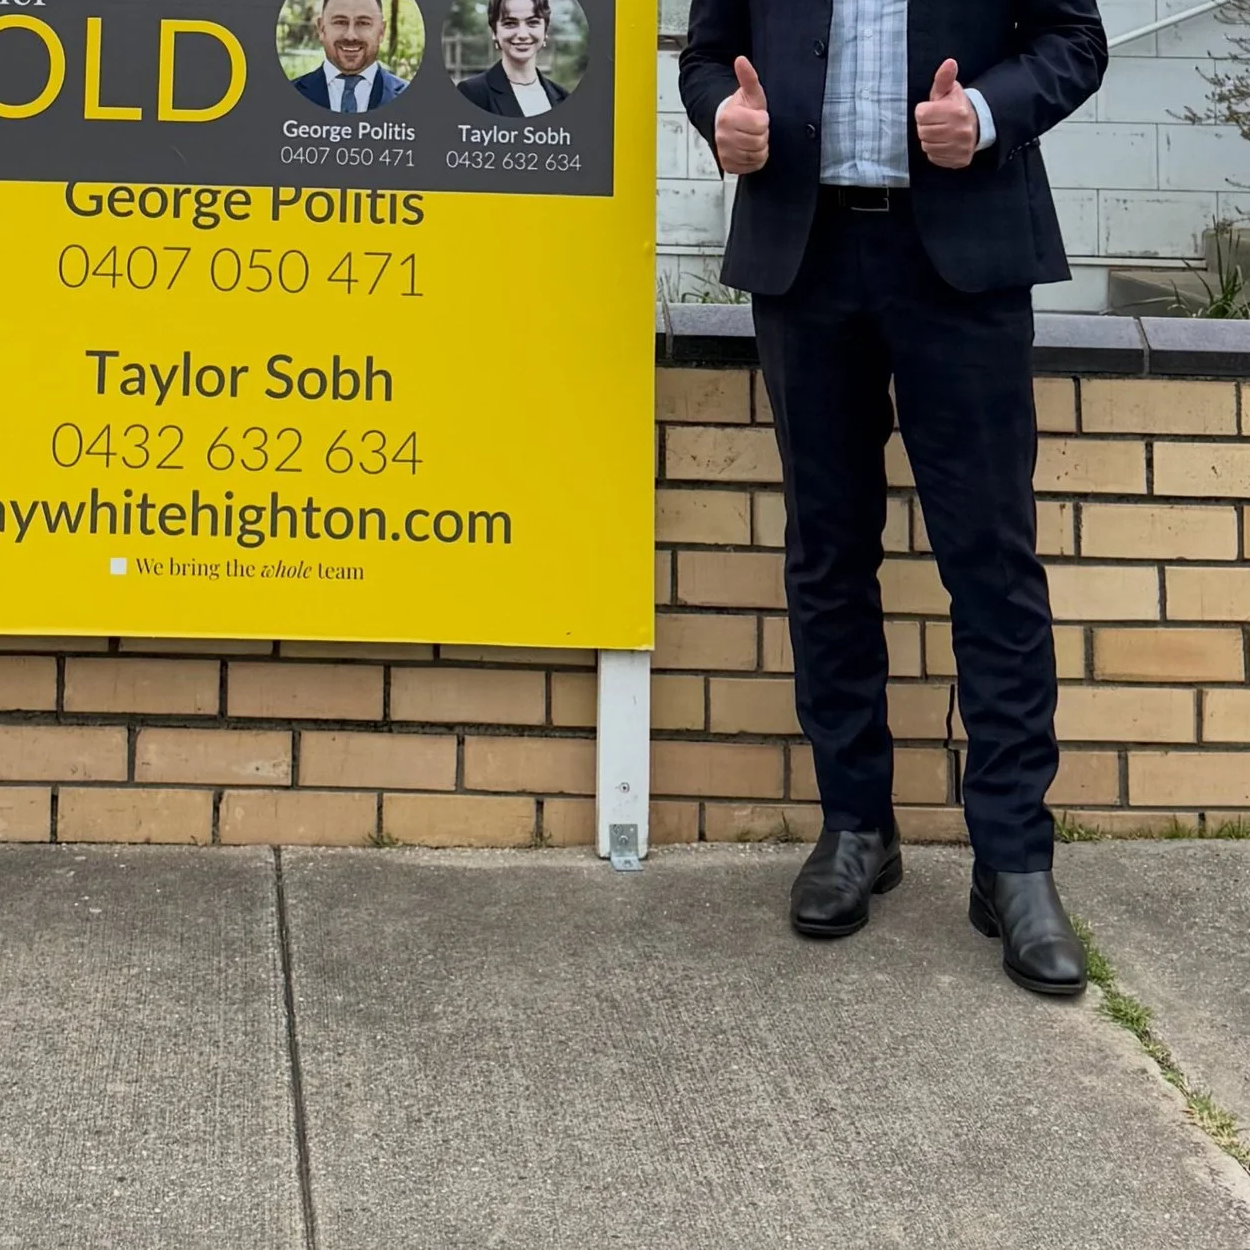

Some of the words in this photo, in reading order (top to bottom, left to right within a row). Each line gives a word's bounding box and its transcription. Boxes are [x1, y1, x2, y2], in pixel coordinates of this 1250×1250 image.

[282, 120, 352, 142] George
[357, 122, 416, 141] Politis
[458, 124, 518, 147] Taylor
[523, 126, 571, 145] Sobh
[280, 146, 330, 165] 0407
[336, 147, 374, 166] 050
[379, 148, 415, 167] 471
[446, 150, 496, 169] 0432
[502, 152, 539, 171] 632
[545, 153, 582, 171] 634
[65, 182, 251, 230] George
[271, 187, 424, 225] Politis
[58, 244, 192, 290] 0407
[210, 247, 310, 294] 050
[326, 251, 424, 297] 471
[85, 349, 250, 407] Taylor
[264, 353, 393, 402] Sobh
[52, 422, 184, 470] 0432
[206, 426, 303, 473] 632
[325, 429, 424, 476] 634
[136, 558, 164, 576] We
[170, 557, 220, 580] bring
[226, 558, 256, 578] the
[260, 559, 312, 580] whole
[318, 562, 364, 580] team
